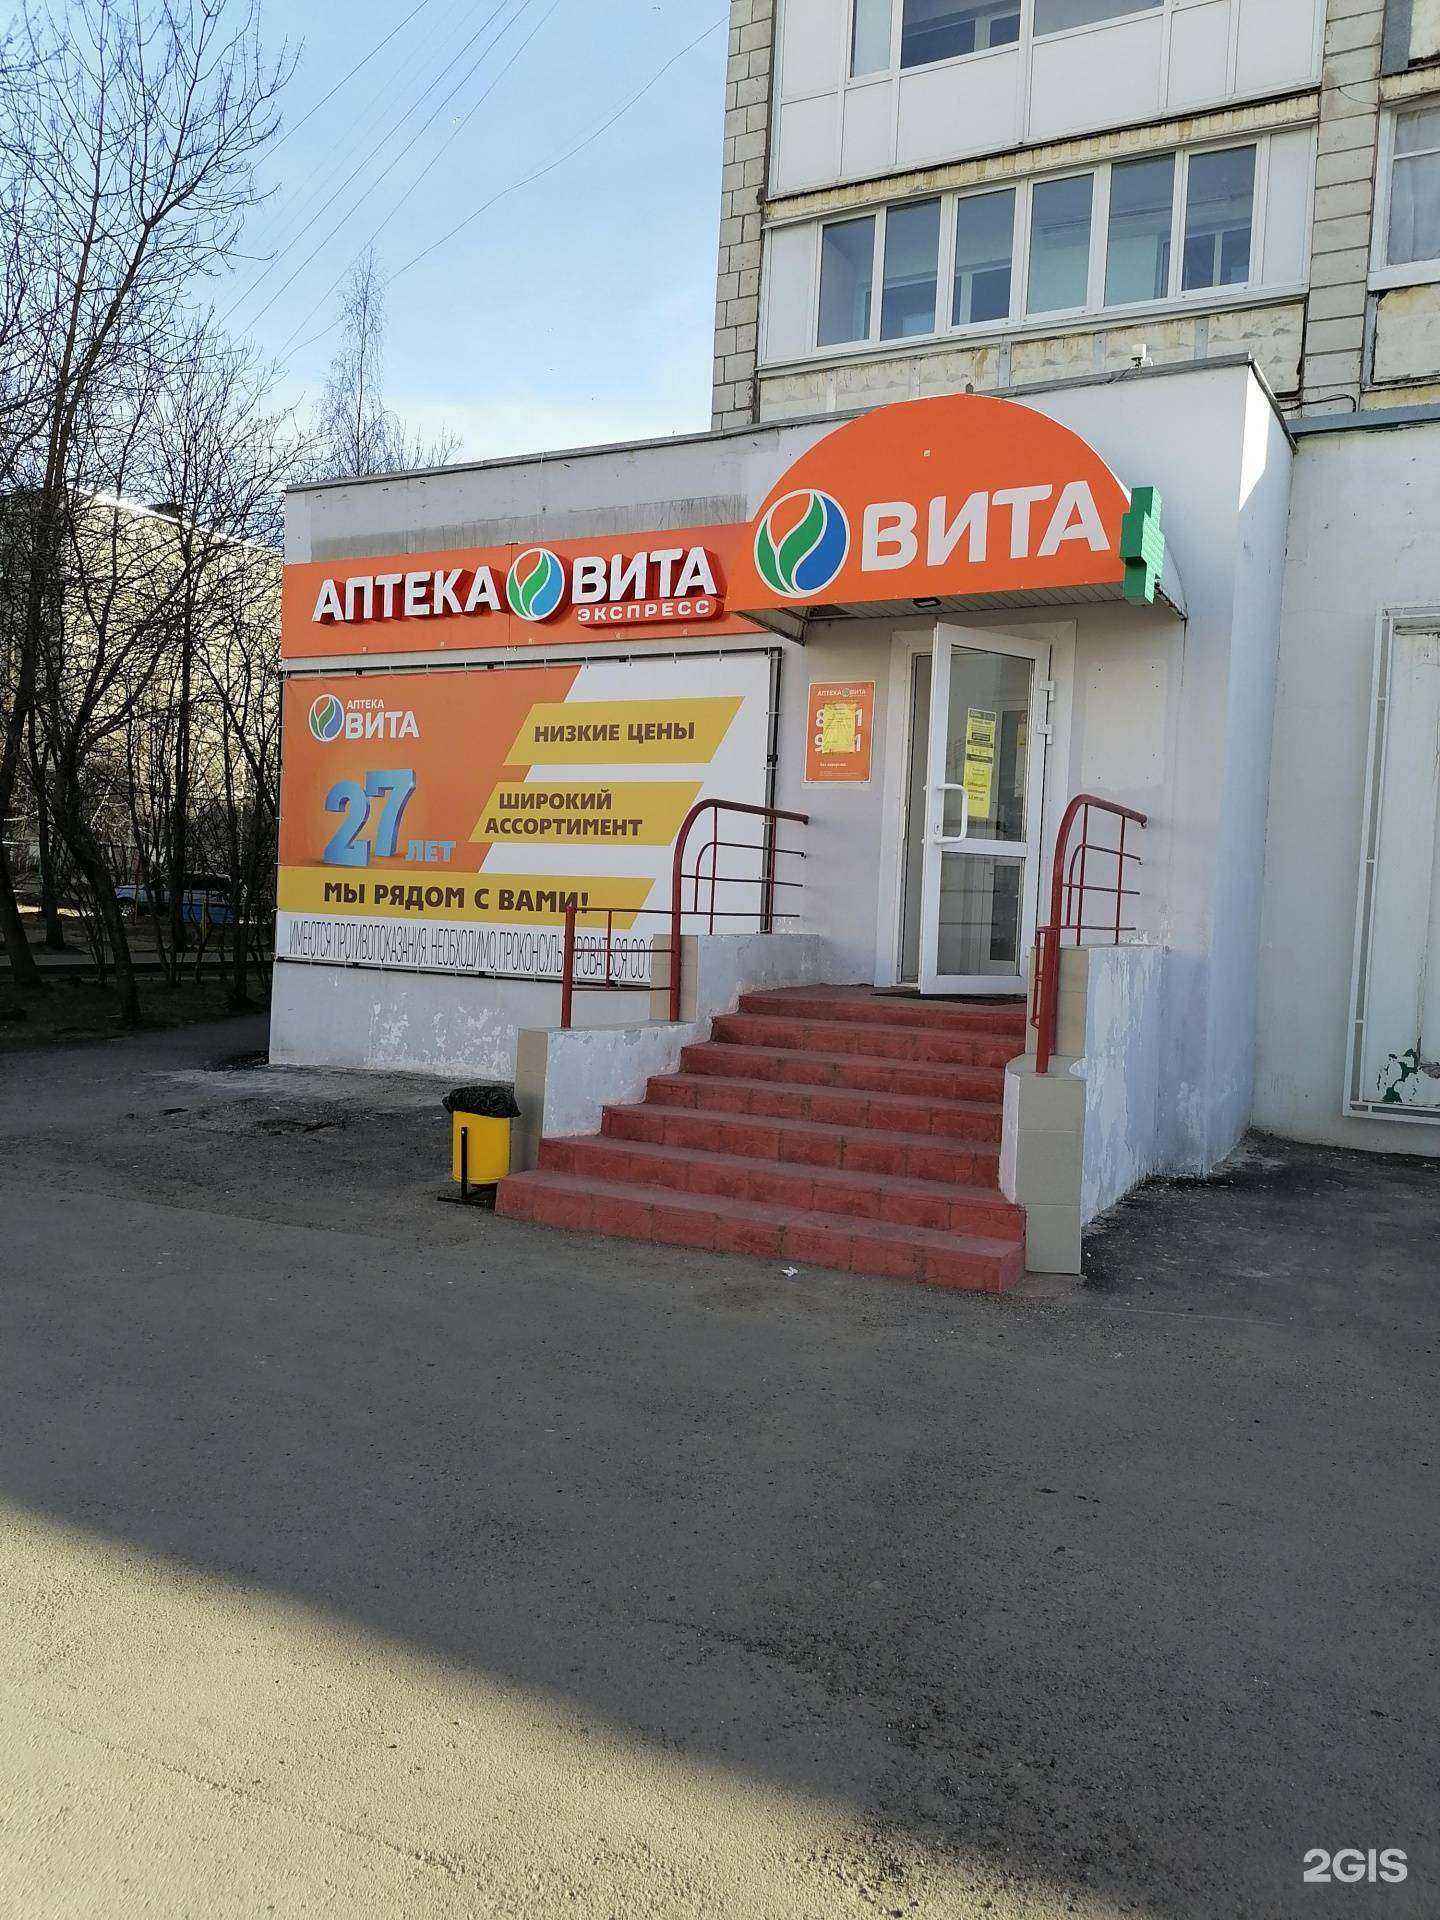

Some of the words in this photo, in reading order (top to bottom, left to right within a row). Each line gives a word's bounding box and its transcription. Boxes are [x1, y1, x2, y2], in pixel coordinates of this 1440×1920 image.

[861, 480, 1111, 572] ВИТА
[312, 565, 502, 622] АПТЕКА
[571, 547, 717, 604] ВИТА
[577, 600, 711, 622] ЭКСПРЕСС
[346, 698, 385, 710] АПТЕКА
[345, 710, 420, 739] ВИТА
[534, 723, 620, 742] НИЗКИЕ
[627, 722, 695, 743] ЦЕНЫ
[499, 787, 612, 810] ШИРОКИЙ
[323, 768, 416, 867] 27
[485, 818, 643, 836] АССОРТИМЕНТ
[405, 839, 456, 863] ЛЕТ
[324, 882, 365, 903] МЫ
[374, 884, 465, 911] РЯДОМ
[475, 888, 490, 910] С
[499, 889, 589, 914] ВАМИ!
[289, 920, 331, 957] ИМЕЮТСЯ
[431, 927, 497, 970] НЕОБХОДИМО
[500, 931, 628, 979] ПРОКОНСУЛЬРОВАТЬСЯ
[631, 938, 646, 979] СО
